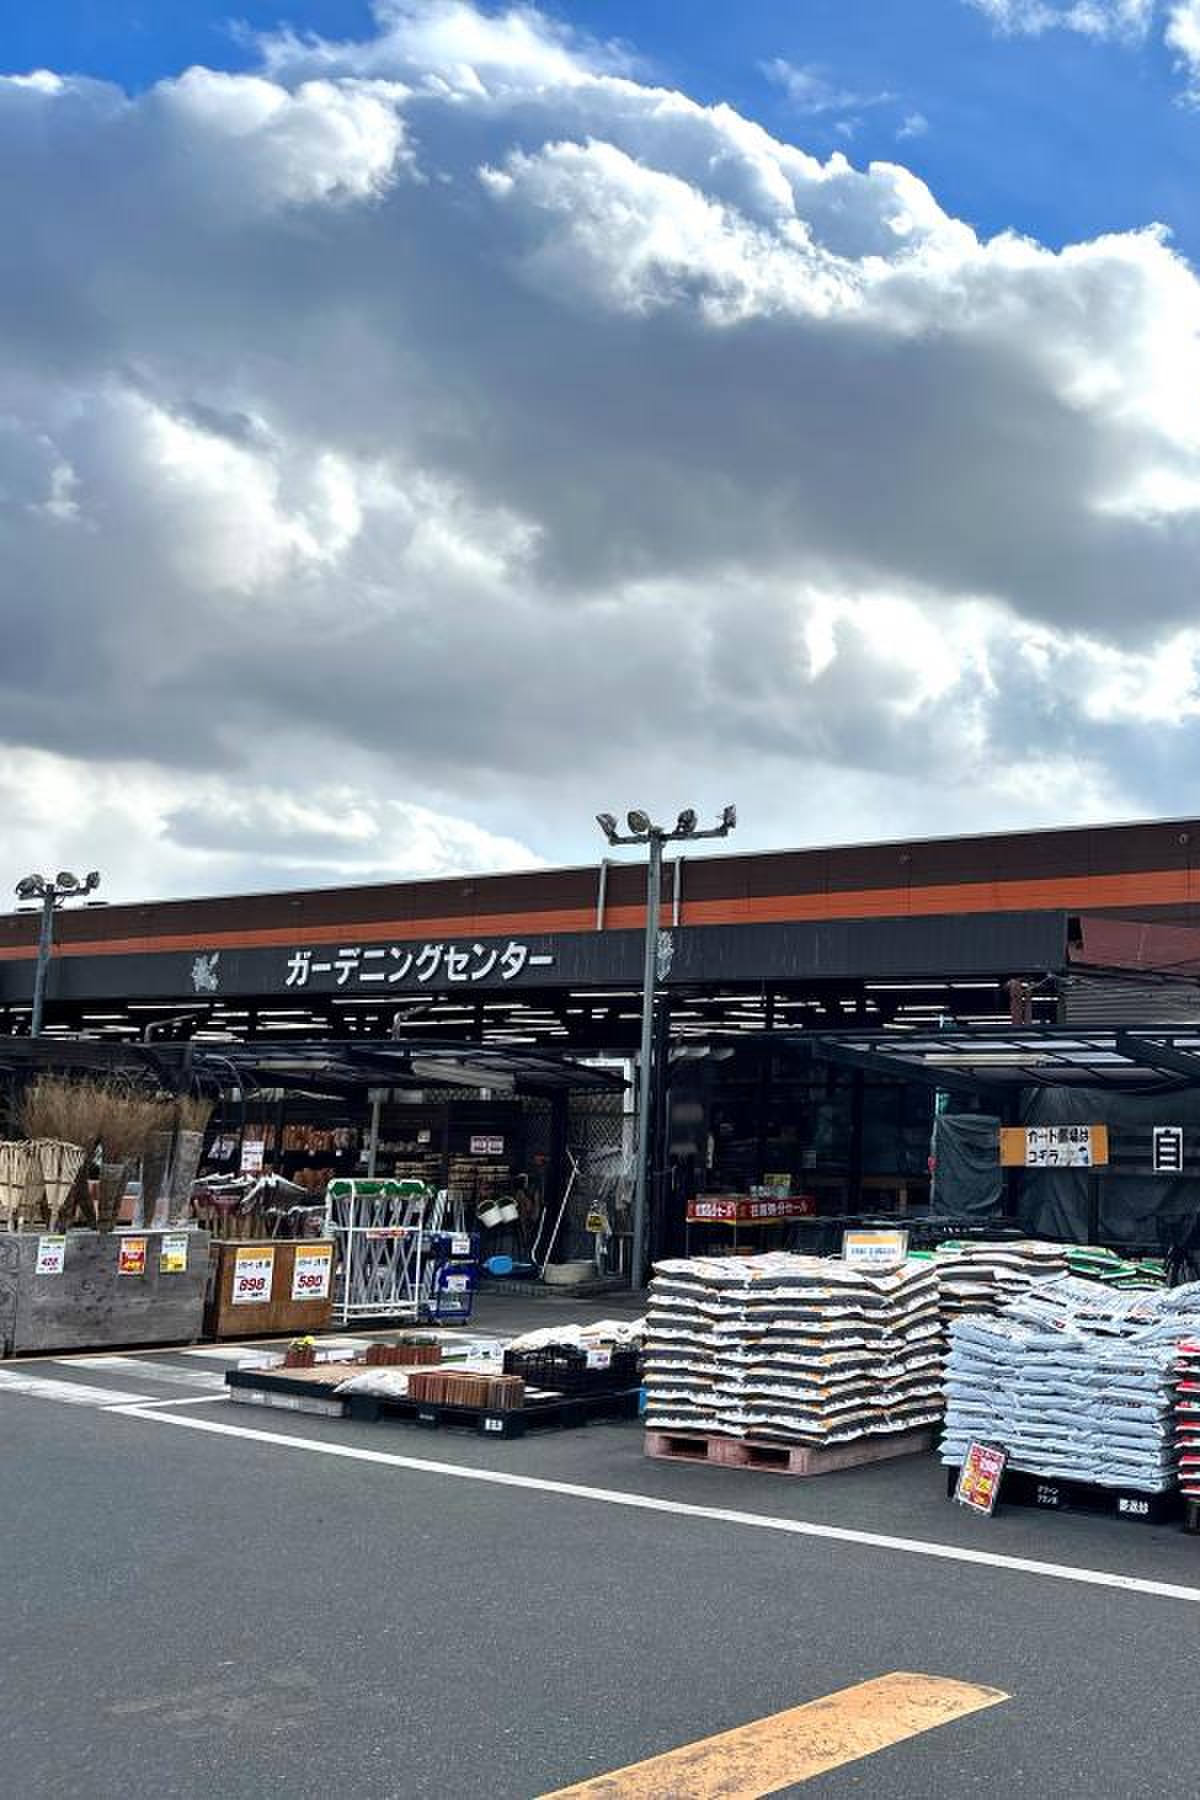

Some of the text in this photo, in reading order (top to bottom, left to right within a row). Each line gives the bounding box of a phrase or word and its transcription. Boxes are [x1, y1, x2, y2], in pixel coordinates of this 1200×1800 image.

[285, 941, 554, 986] ガーデニングセンター
